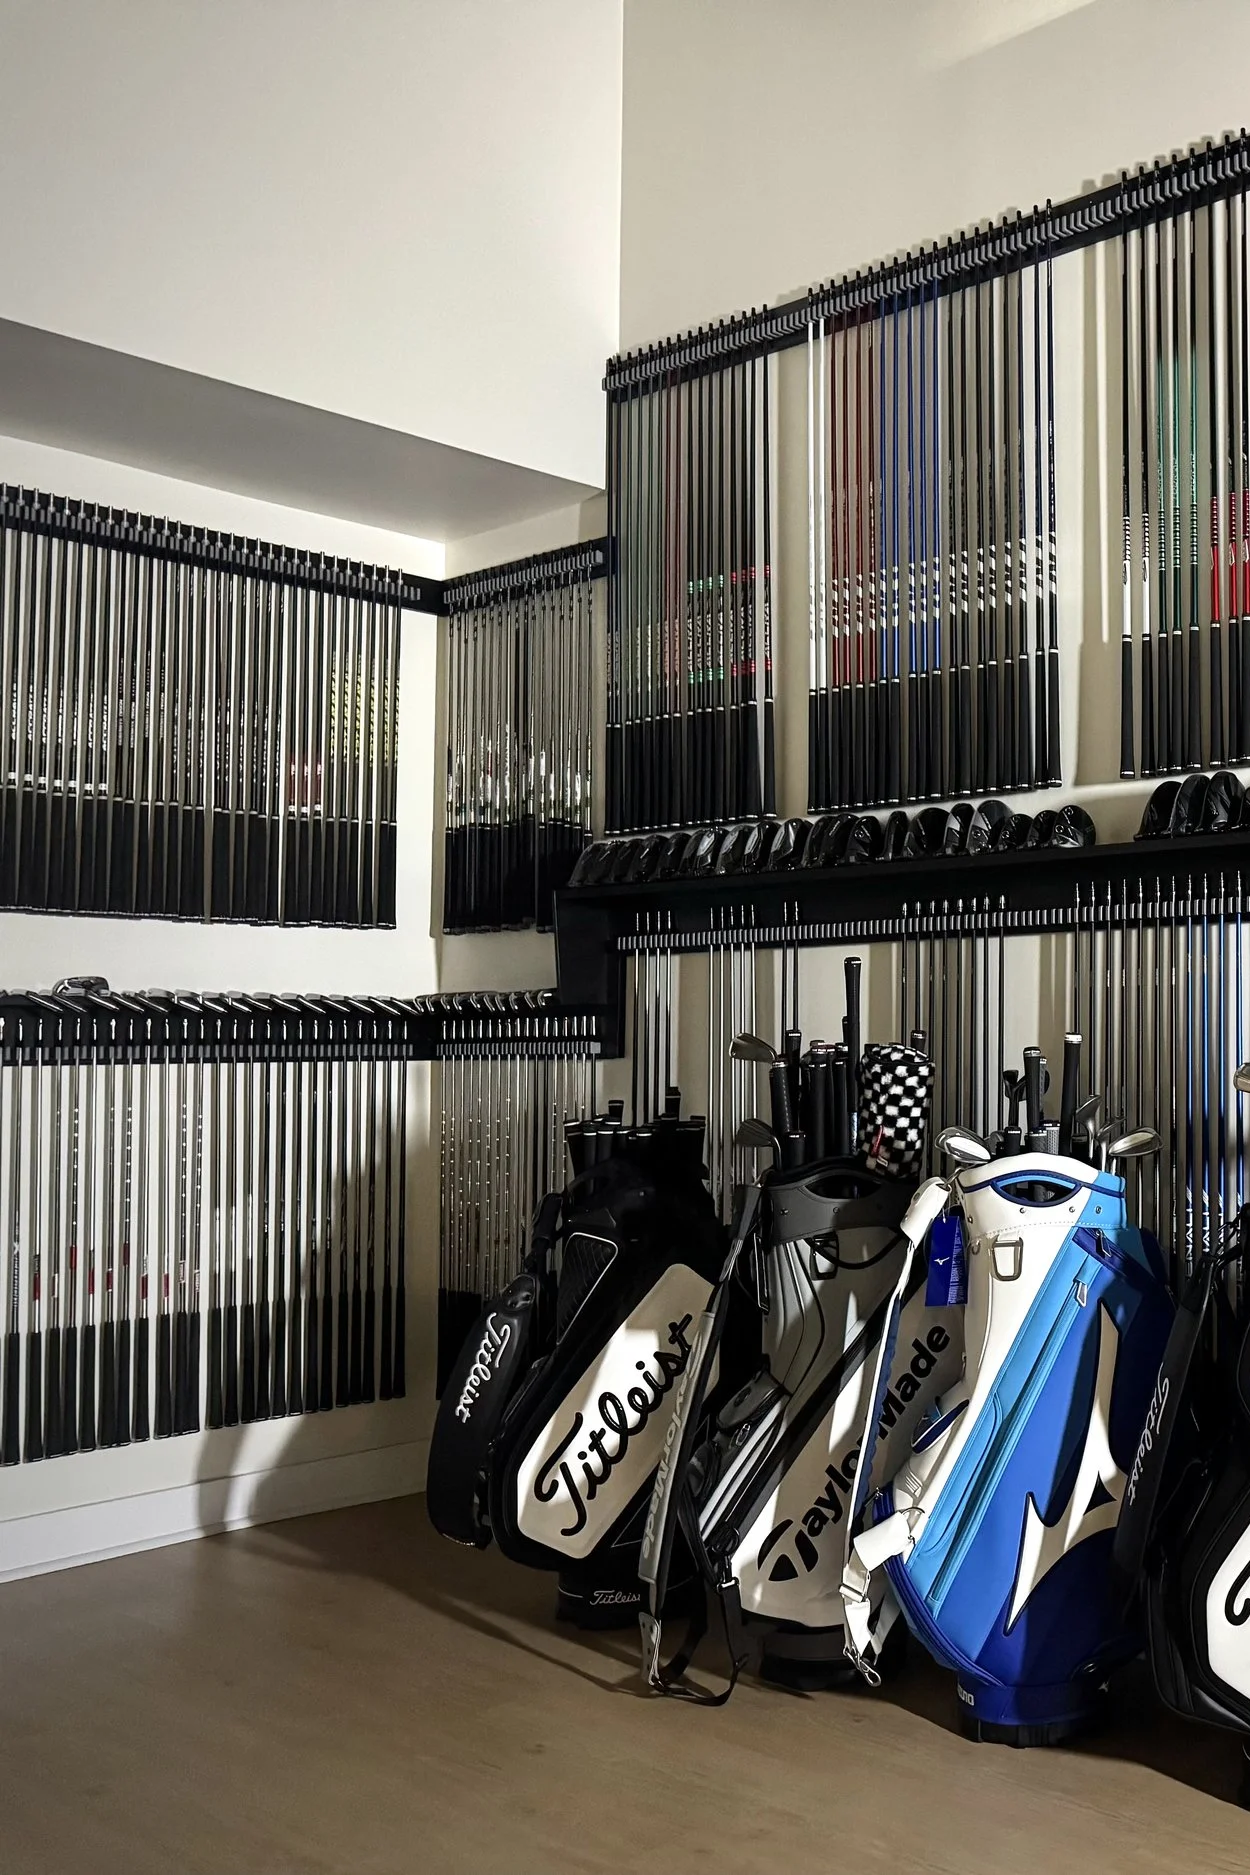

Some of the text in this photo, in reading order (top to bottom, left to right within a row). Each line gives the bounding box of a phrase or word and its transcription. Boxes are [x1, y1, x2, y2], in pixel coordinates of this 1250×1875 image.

[455, 1312, 512, 1425] Titleist
[533, 1314, 694, 1537] Titleist
[757, 1325, 951, 1582] TayloMade
[1128, 1362, 1170, 1505] Titleist
